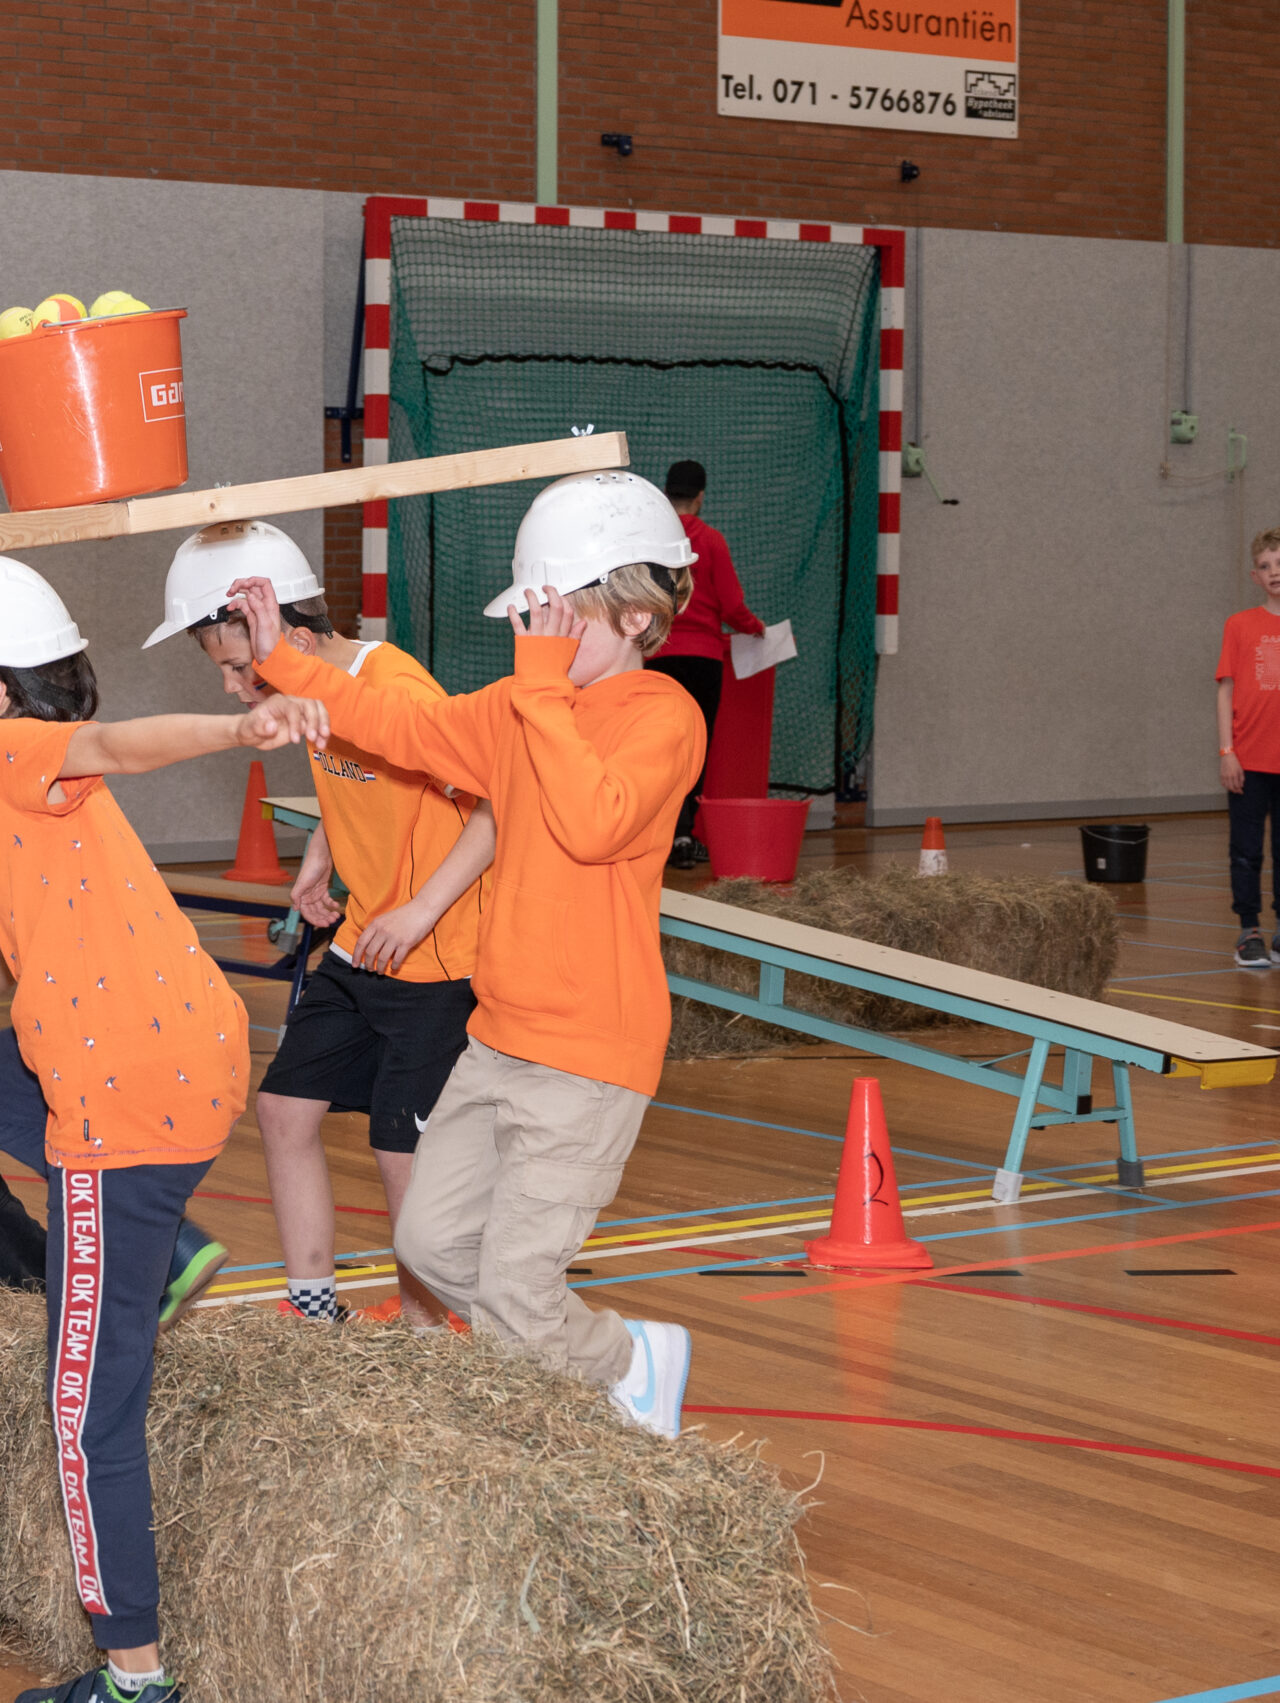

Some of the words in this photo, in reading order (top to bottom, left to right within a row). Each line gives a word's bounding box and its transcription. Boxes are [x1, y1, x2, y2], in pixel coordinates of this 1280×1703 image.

[845, 0, 1013, 43] Assurantiën
[721, 74, 763, 101] Tel.
[773, 79, 817, 105] 071
[849, 86, 957, 116] 5766876
[318, 751, 368, 783] OLLAND
[70, 1173, 95, 1205] OK
[862, 1150, 888, 1206] 2
[72, 1209, 96, 1264] TEAM
[71, 1274, 95, 1304] OK
[65, 1306, 93, 1362] TEAM
[60, 1371, 84, 1400] OK
[60, 1405, 82, 1462] TEAM
[65, 1472, 81, 1504] OK
[70, 1507, 89, 1566] TEAM
[80, 1574, 102, 1607] OK
